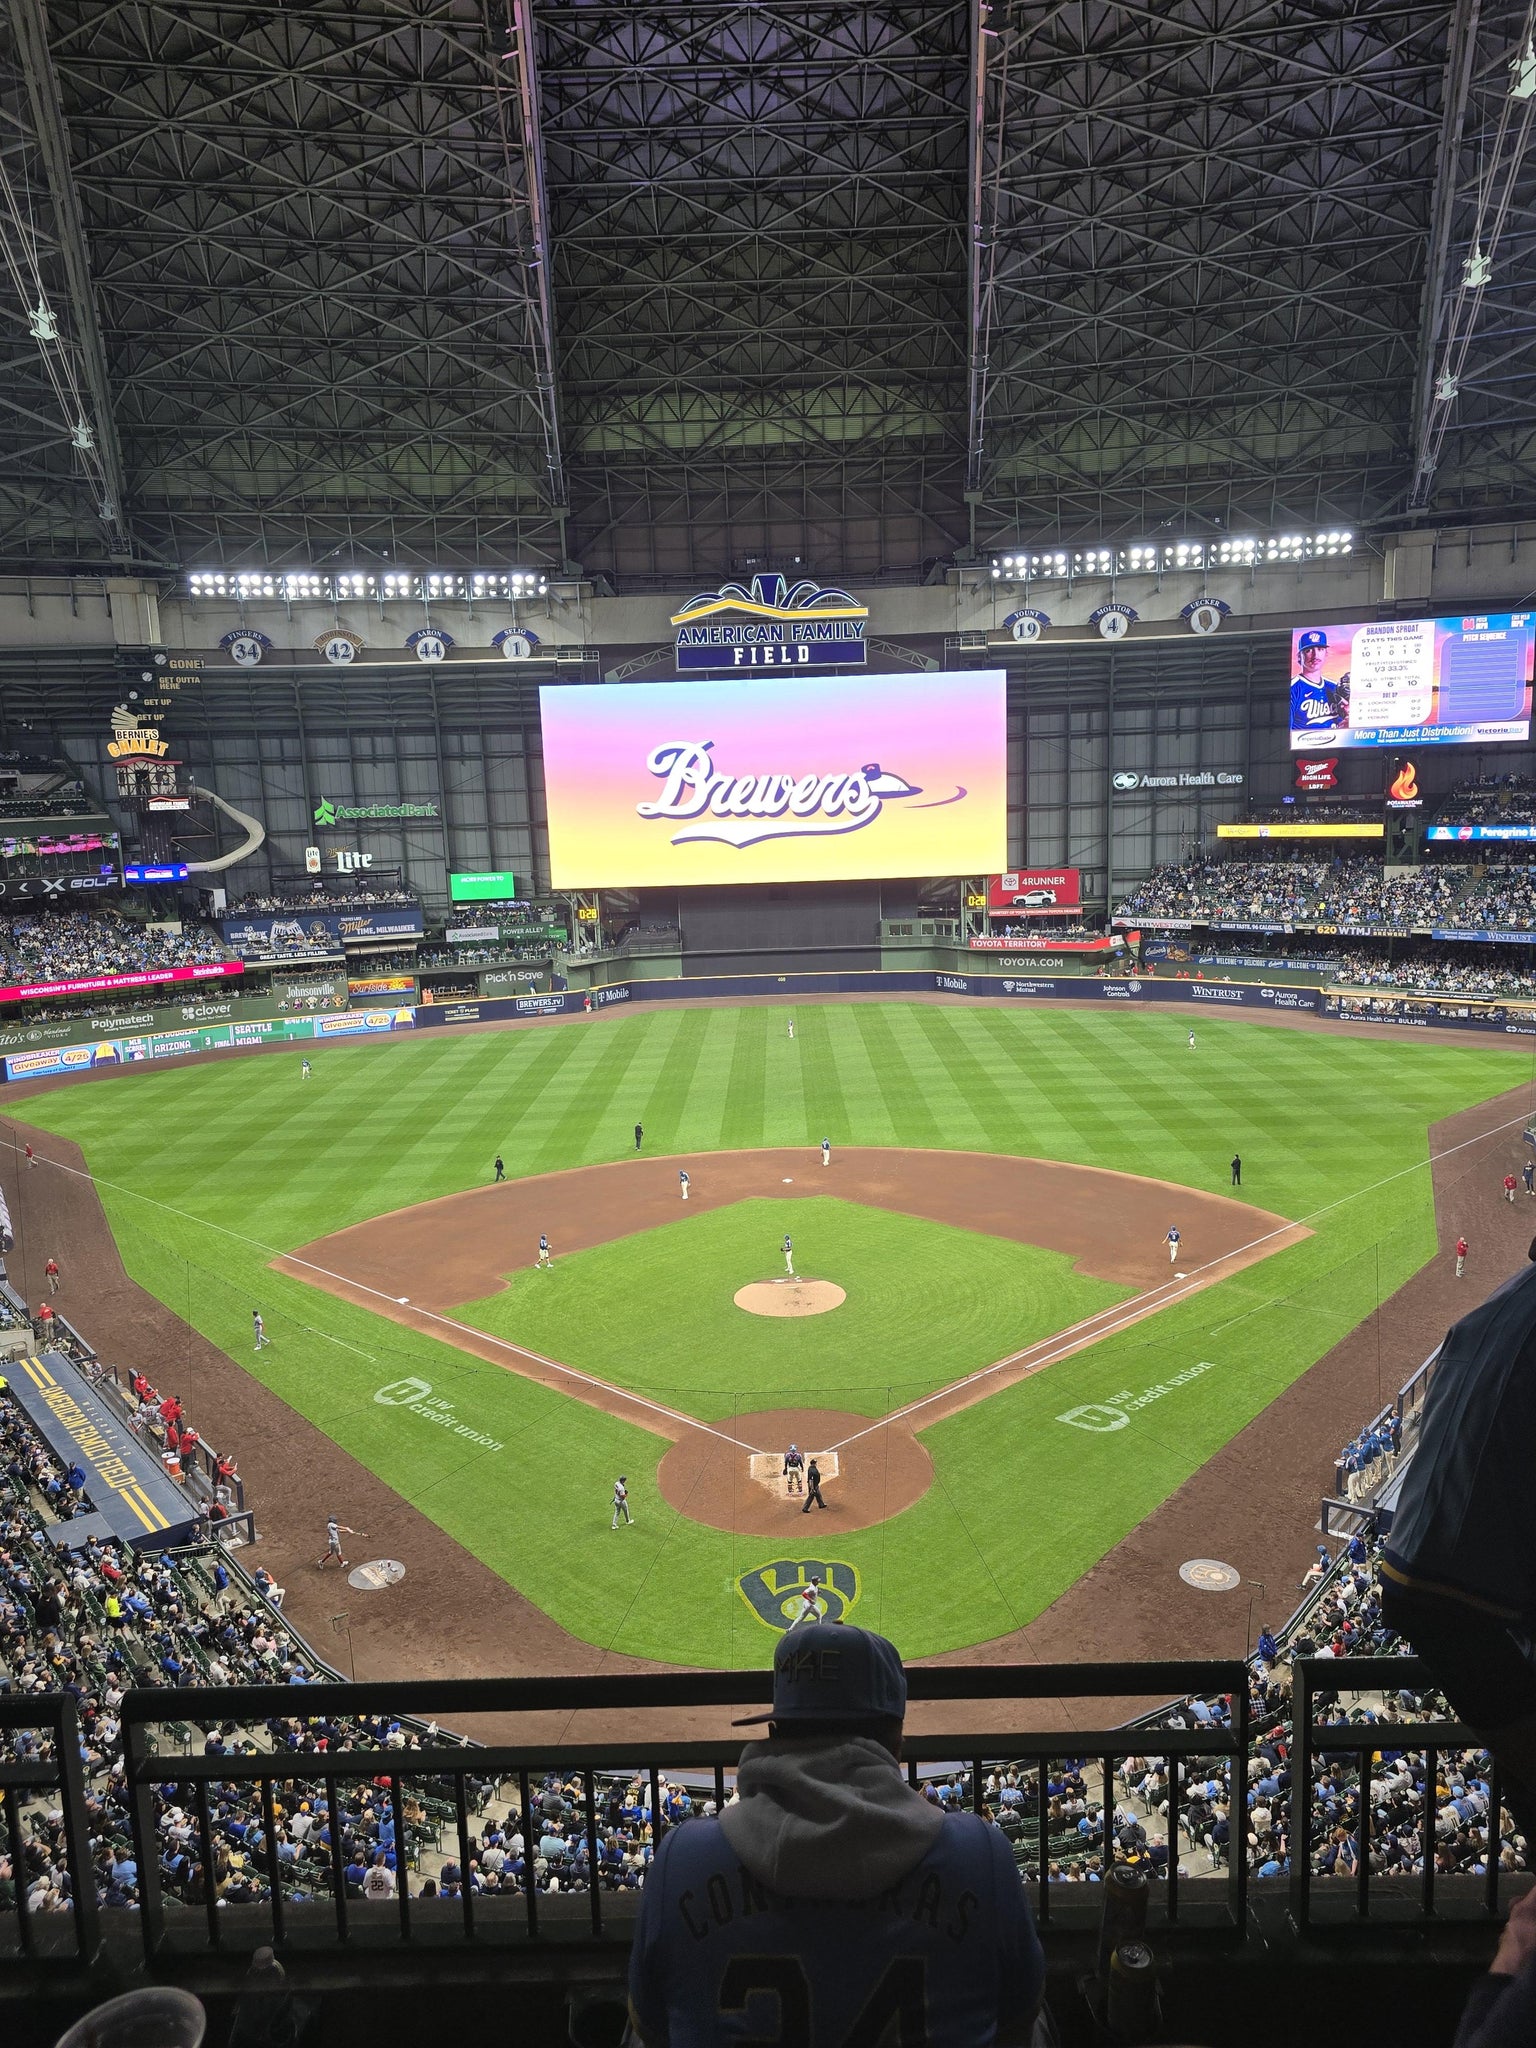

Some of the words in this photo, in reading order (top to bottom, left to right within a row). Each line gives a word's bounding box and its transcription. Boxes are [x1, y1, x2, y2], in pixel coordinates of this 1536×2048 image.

[1096, 605, 1131, 615] MOLITOR
[1190, 599, 1220, 609] UECKER
[1013, 610, 1040, 618] YOUNT
[504, 628, 527, 636] SELIG
[1017, 623, 1038, 638] 19
[1107, 618, 1118, 633] 4
[1366, 626, 1395, 635] BRANDON
[1396, 624, 1419, 634] SPROAT
[227, 630, 263, 641] FINGERS
[417, 630, 442, 638] AARON
[677, 624, 784, 645] AMERICAN
[792, 621, 866, 641] FAMILY
[235, 643, 259, 660] 34
[328, 643, 351, 659] 42
[420, 642, 442, 658] 44
[512, 641, 522, 657] 1
[734, 645, 809, 665] FIELD
[169, 659, 205, 669] GONE!
[159, 676, 175, 684] GET
[176, 676, 200, 684] OUTTA
[116, 729, 159, 740] BERNIE'S
[1354, 730, 1376, 740] More
[1378, 730, 1399, 739] Than
[1400, 729, 1420, 738] Just
[1421, 727, 1473, 738] Distribution!
[106, 740, 169, 757] CHALET
[636, 739, 883, 821] Brewers
[1140, 775, 1177, 787] Aurora
[1179, 771, 1215, 786] Health
[1217, 773, 1243, 784] Care
[1481, 827, 1528, 840] Peregrine
[337, 852, 372, 873] Lite
[41, 878, 66, 892] X
[70, 877, 118, 889] GOLF
[1022, 876, 1065, 886] 4RUNNER
[968, 895, 986, 906] 0:28
[579, 908, 597, 919] 0:28
[338, 918, 372, 933] Miller
[357, 928, 375, 936] TIME,
[376, 924, 415, 934] MILWAUKEE
[1317, 926, 1337, 934] 620
[1338, 926, 1371, 936] WTMJ
[1486, 932, 1532, 941] WINTRUST
[972, 940, 1002, 948] TOYOTA
[1005, 940, 1047, 948] TERRITORY
[278, 952, 294, 960] TASTE.
[998, 957, 1064, 967] TOYOTA.COM
[1216, 957, 1237, 966] WELCOME
[1244, 959, 1266, 967] DELICIOUS
[1287, 961, 1309, 970] WELCOME
[1316, 962, 1339, 971] DELICIOUS
[485, 972, 506, 984] Pick
[517, 970, 544, 981] Save
[943, 977, 967, 990] Mobile
[20, 986, 67, 996] WISCONSIN'S
[67, 980, 106, 991] FURNITURE
[113, 975, 146, 985] MATTRESS
[148, 972, 173, 982] LEADER
[286, 983, 335, 998] Johnsonville
[352, 982, 388, 994] Surfside
[606, 988, 630, 1001] Mobile
[1192, 986, 1244, 998] WINTRUST
[1275, 991, 1298, 999] Aurora
[519, 997, 562, 1009] BREWERS.TV
[1274, 998, 1297, 1007] Health
[1298, 1000, 1315, 1008] Care
[195, 1004, 231, 1017] clover
[91, 1013, 154, 1029] Polymatech
[324, 1019, 362, 1030] Giveaway
[1350, 1013, 1366, 1021] Aurora
[1366, 1015, 1383, 1023] Health
[1398, 1018, 1427, 1026] BULLPEN
[235, 1023, 272, 1034] SEATTLE
[154, 1040, 191, 1053] ARIZONA
[205, 1037, 211, 1045] 3
[215, 1040, 230, 1048] FINAL
[236, 1036, 263, 1046] MIAMI
[65, 1052, 89, 1062] 4/25
[14, 1057, 58, 1071] Giveaway
[1125, 1384, 1173, 1411] credit
[1167, 1361, 1216, 1386] union
[426, 1396, 455, 1410] uw
[1105, 1389, 1134, 1404] uw
[82, 1399, 119, 1441] WELCOME
[120, 1444, 132, 1456] TO
[409, 1403, 458, 1427] credit
[454, 1424, 505, 1451] union
[39, 1386, 91, 1433] AMERICAN
[72, 1423, 116, 1461] FAMILY
[95, 1457, 137, 1489] FIELD
[774, 1650, 841, 1688] MKE
[371, 1880, 384, 1891] 22
